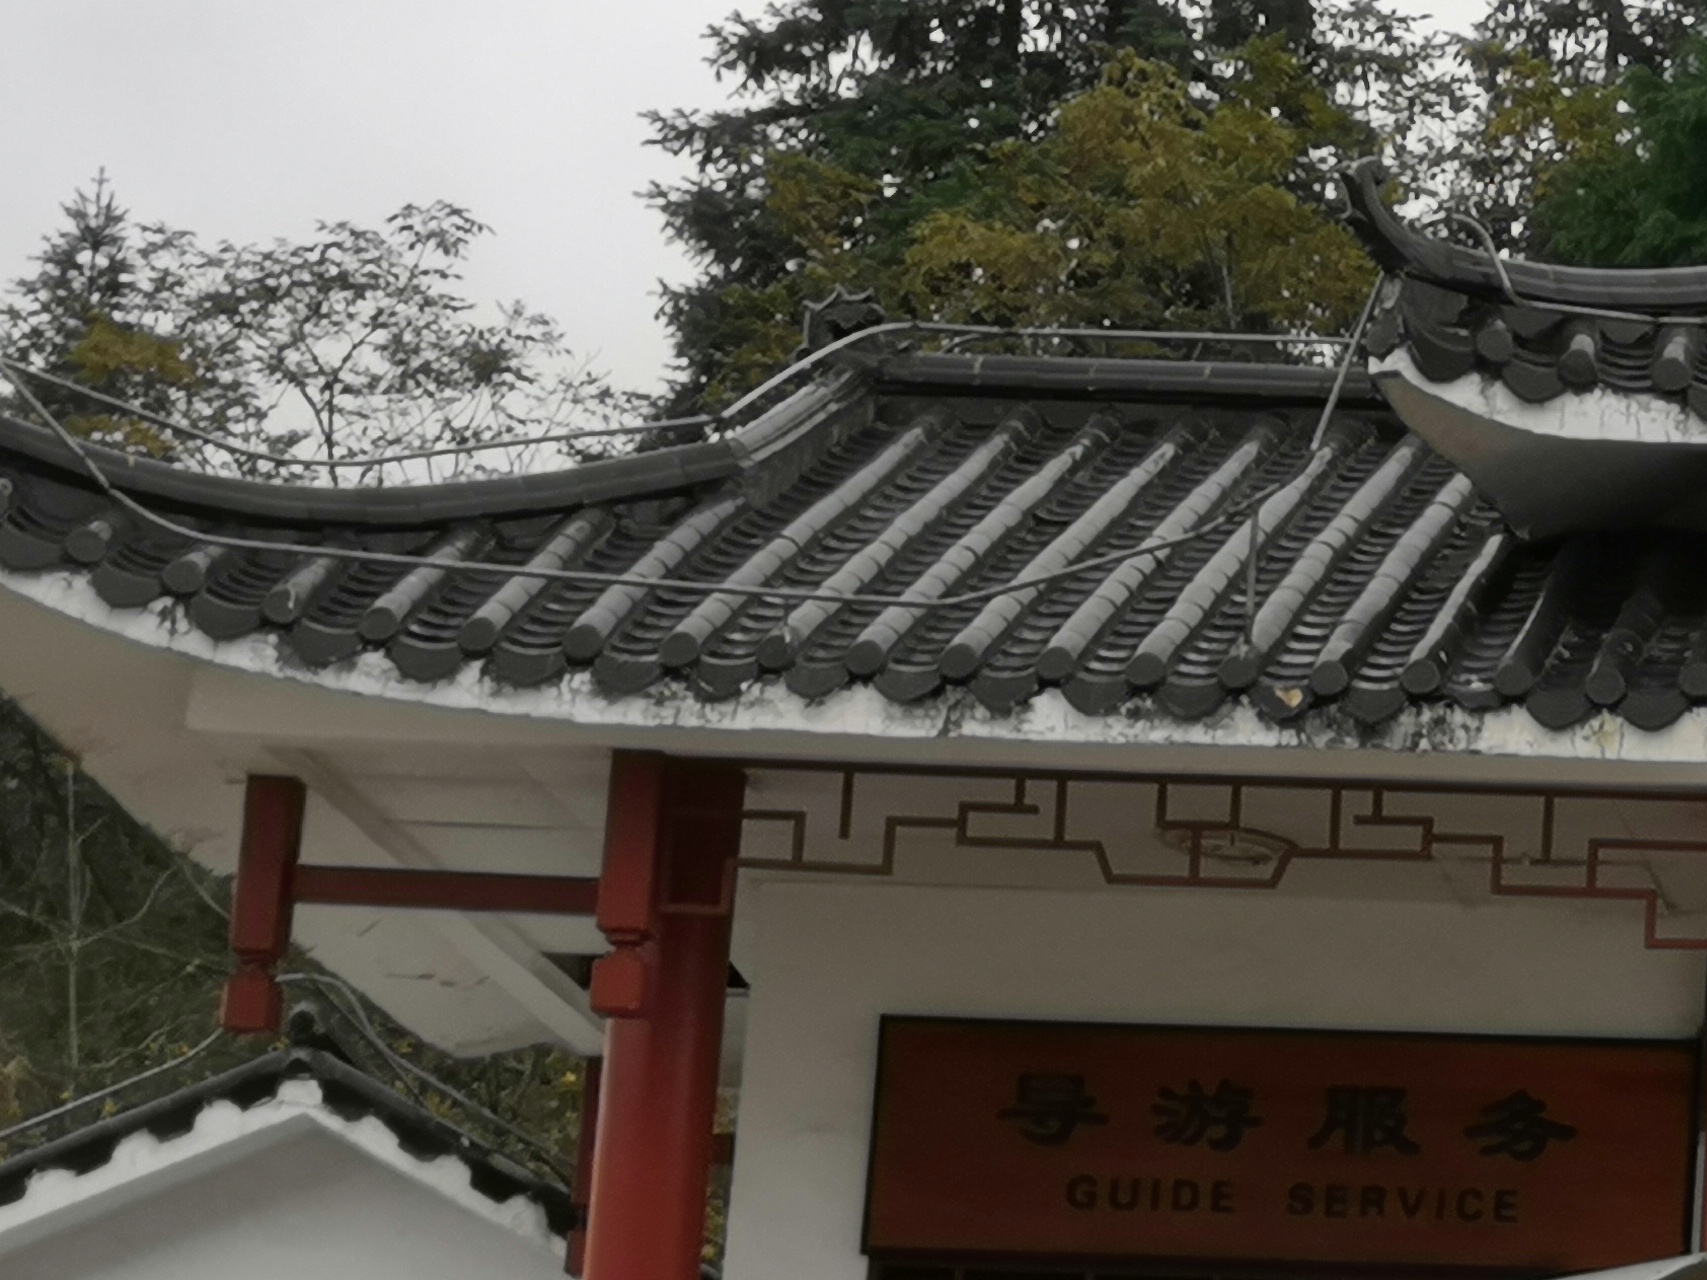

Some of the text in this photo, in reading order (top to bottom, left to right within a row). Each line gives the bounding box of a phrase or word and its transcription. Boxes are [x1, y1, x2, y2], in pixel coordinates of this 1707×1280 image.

[995, 1070, 1580, 1162] 导游服务
[1065, 1173, 1522, 1225] GUIDE SERVICE
